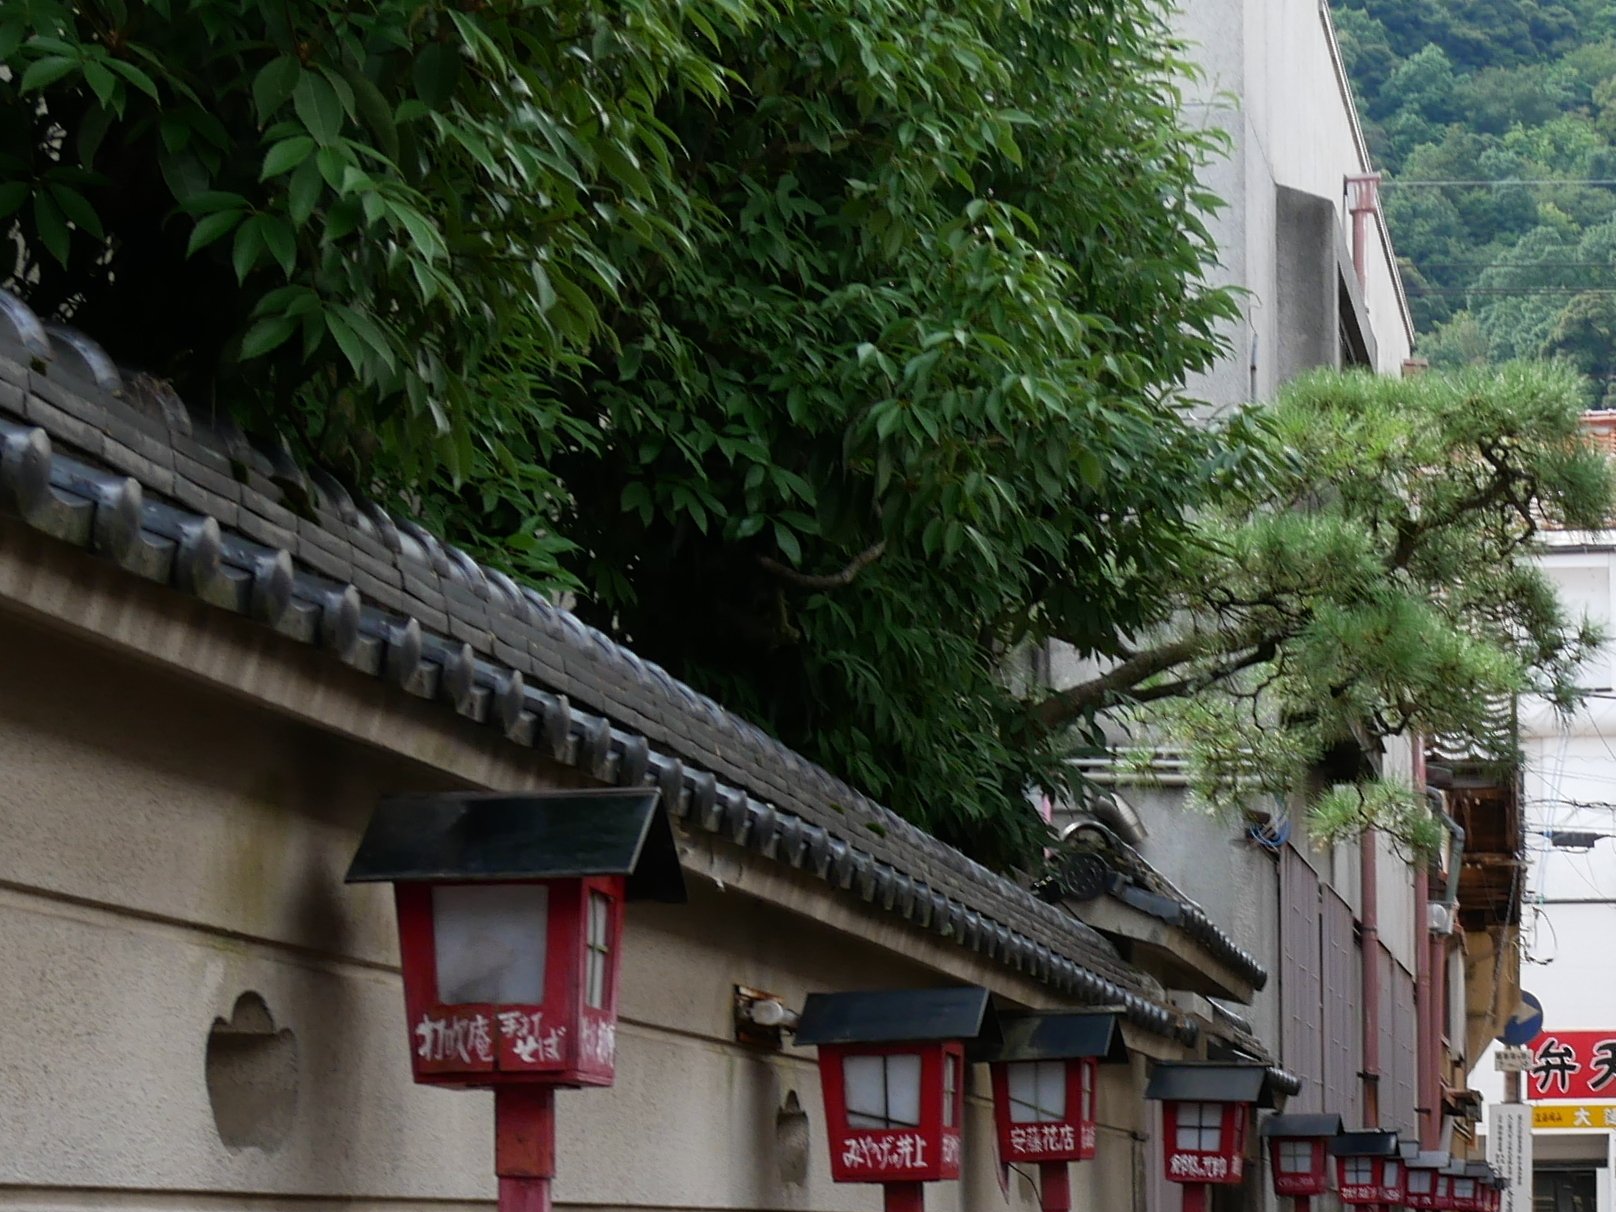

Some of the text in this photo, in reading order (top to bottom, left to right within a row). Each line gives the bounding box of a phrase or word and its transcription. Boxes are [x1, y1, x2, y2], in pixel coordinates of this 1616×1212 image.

[842, 1133, 928, 1170] みやげの井上
